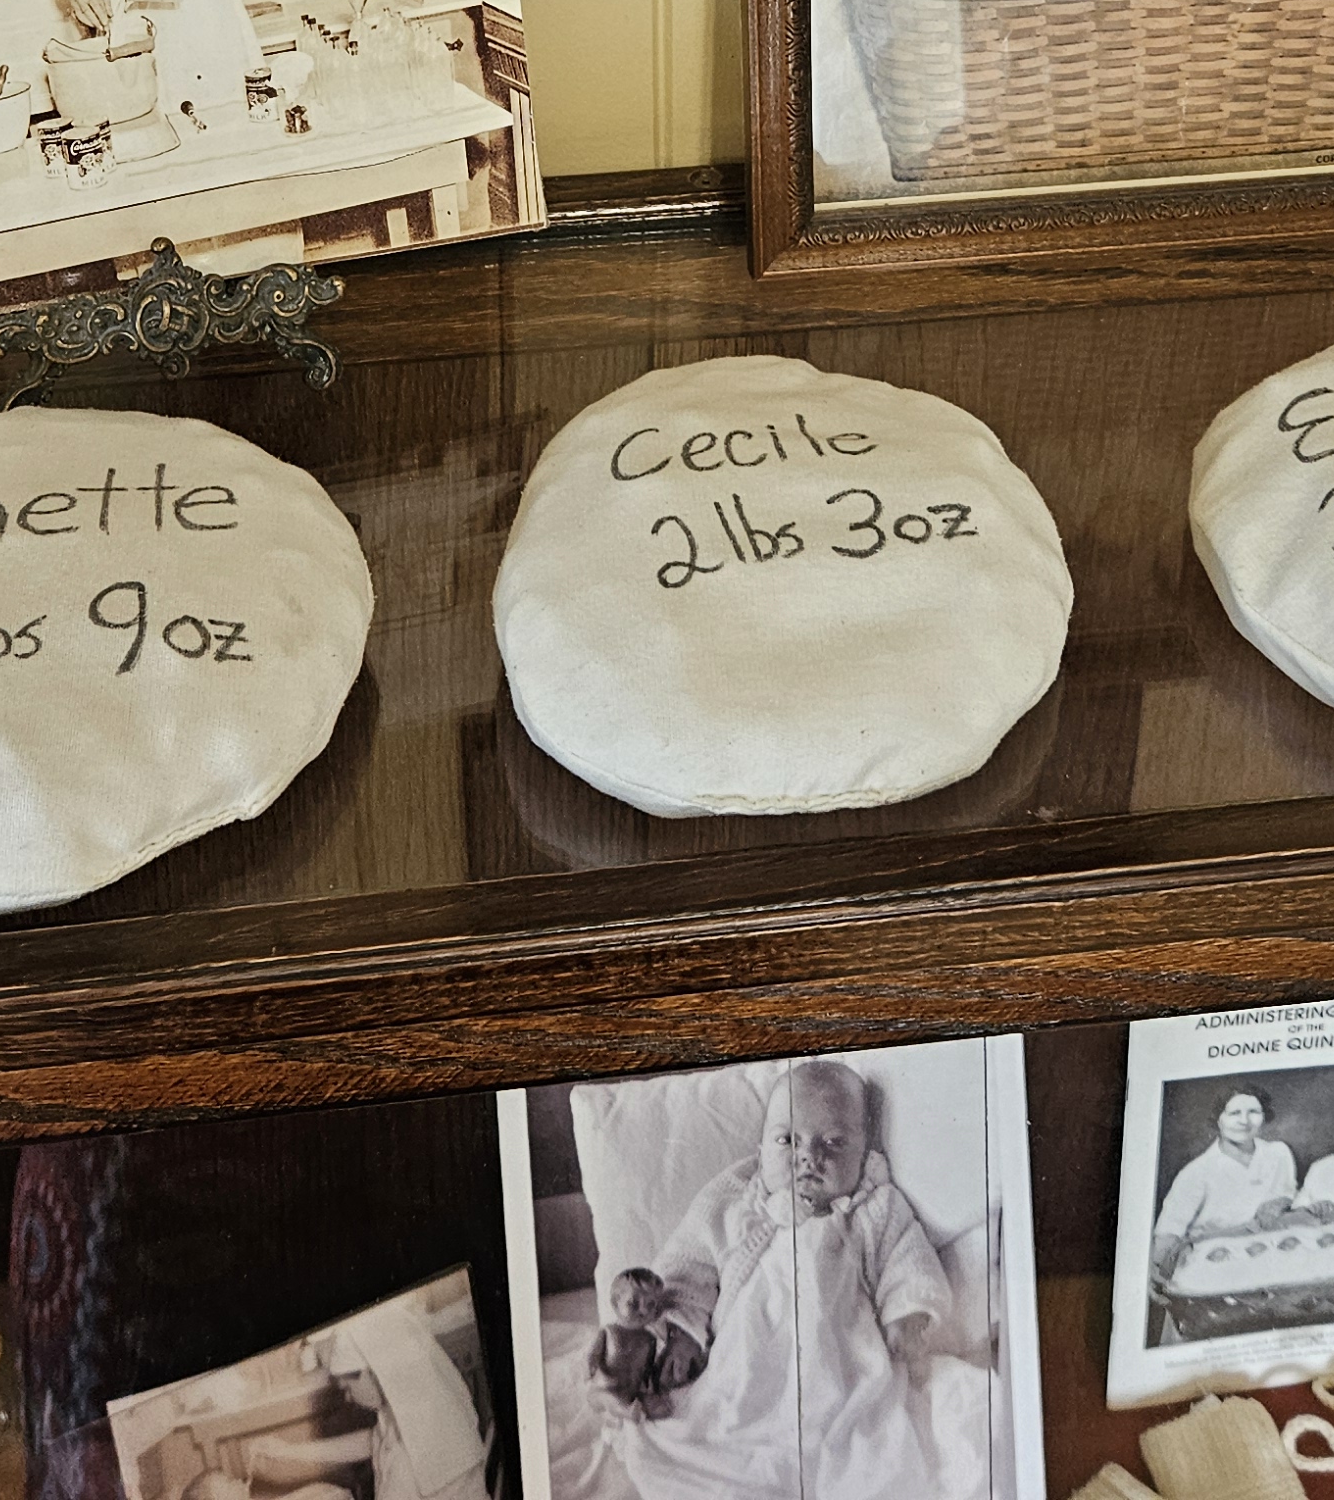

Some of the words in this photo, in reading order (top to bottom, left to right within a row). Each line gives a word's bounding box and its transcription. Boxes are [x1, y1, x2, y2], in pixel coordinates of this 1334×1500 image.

[610, 413, 878, 482] Cecile
[650, 493, 805, 589] 2lbs
[826, 488, 978, 558] 3oz
[1207, 1038, 1282, 1059] DIONNE
[1288, 1024, 1303, 1034] OF
